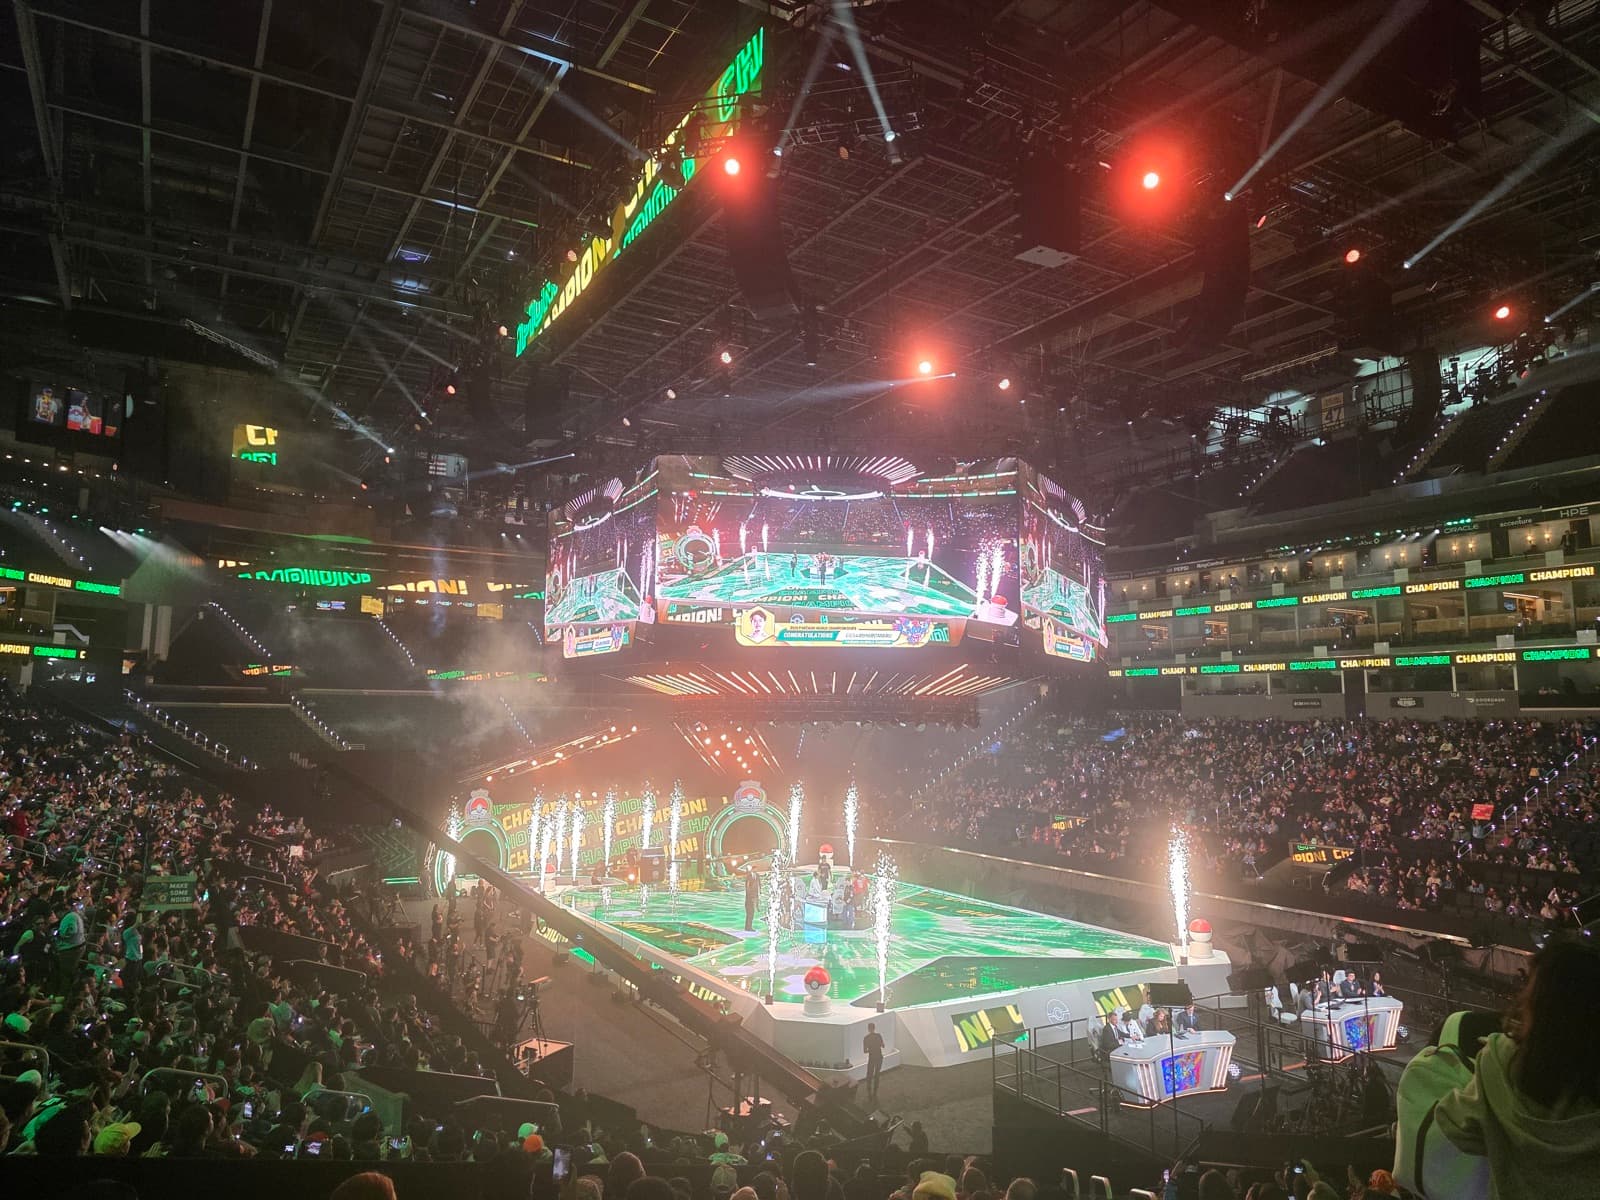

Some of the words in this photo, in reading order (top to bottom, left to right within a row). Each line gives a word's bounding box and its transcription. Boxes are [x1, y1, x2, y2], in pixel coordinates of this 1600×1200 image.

[1560, 507, 1588, 518] HPE
[28, 572, 72, 588] CHAMPION!
[1139, 609, 1173, 620] CHAMPION!
[1302, 591, 1348, 604] CHAMPION!
[1405, 580, 1460, 594] CHAMPION!
[1529, 566, 1595, 582] CHAMPION!
[1243, 662, 1286, 672] CHAMPION!
[1340, 658, 1391, 669] CHAMPION!
[1455, 652, 1517, 664] CHAMPION!
[1522, 648, 1590, 661] CHAMPION!
